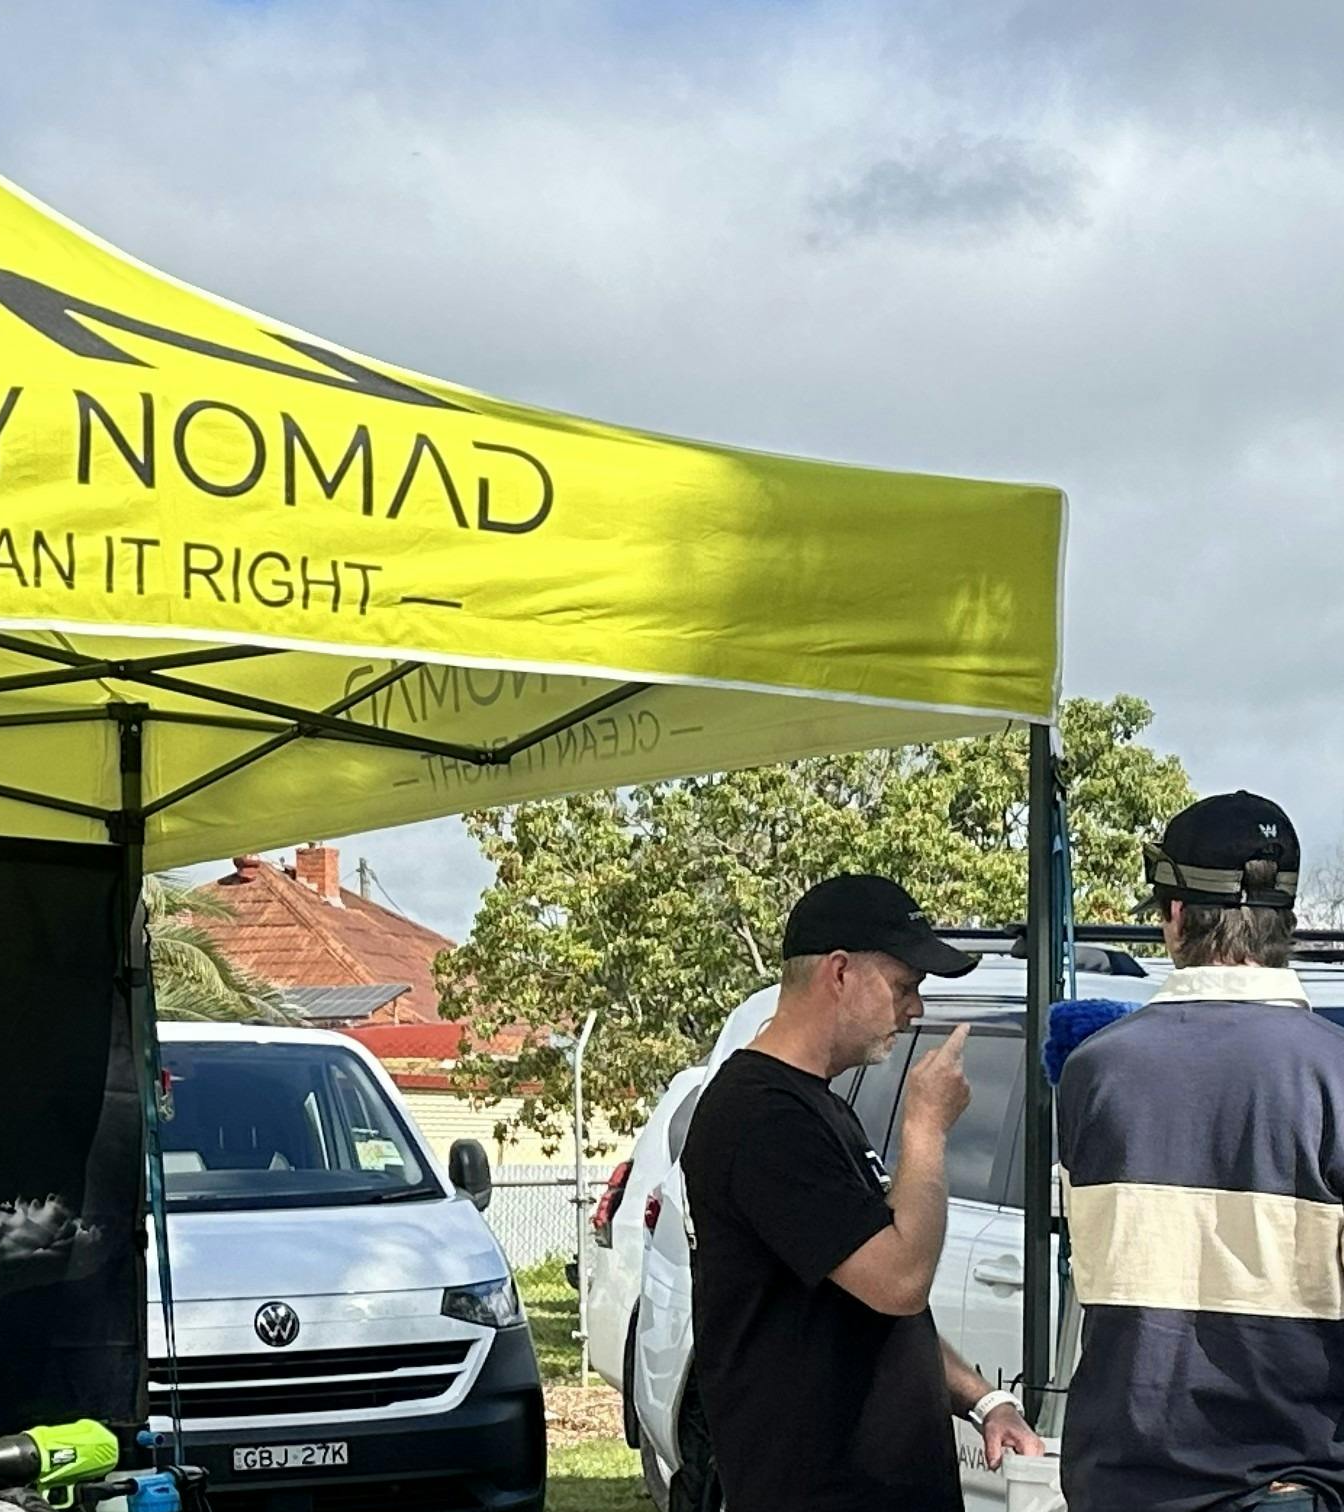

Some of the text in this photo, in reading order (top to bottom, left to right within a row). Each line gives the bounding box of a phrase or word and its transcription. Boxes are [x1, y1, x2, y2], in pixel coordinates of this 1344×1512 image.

[74, 388, 554, 534] NOMAD
[104, 538, 161, 596] IT
[182, 543, 383, 615] RIGHT
[244, 1448, 288, 1469] GBJ
[302, 1444, 345, 1465] 27K
